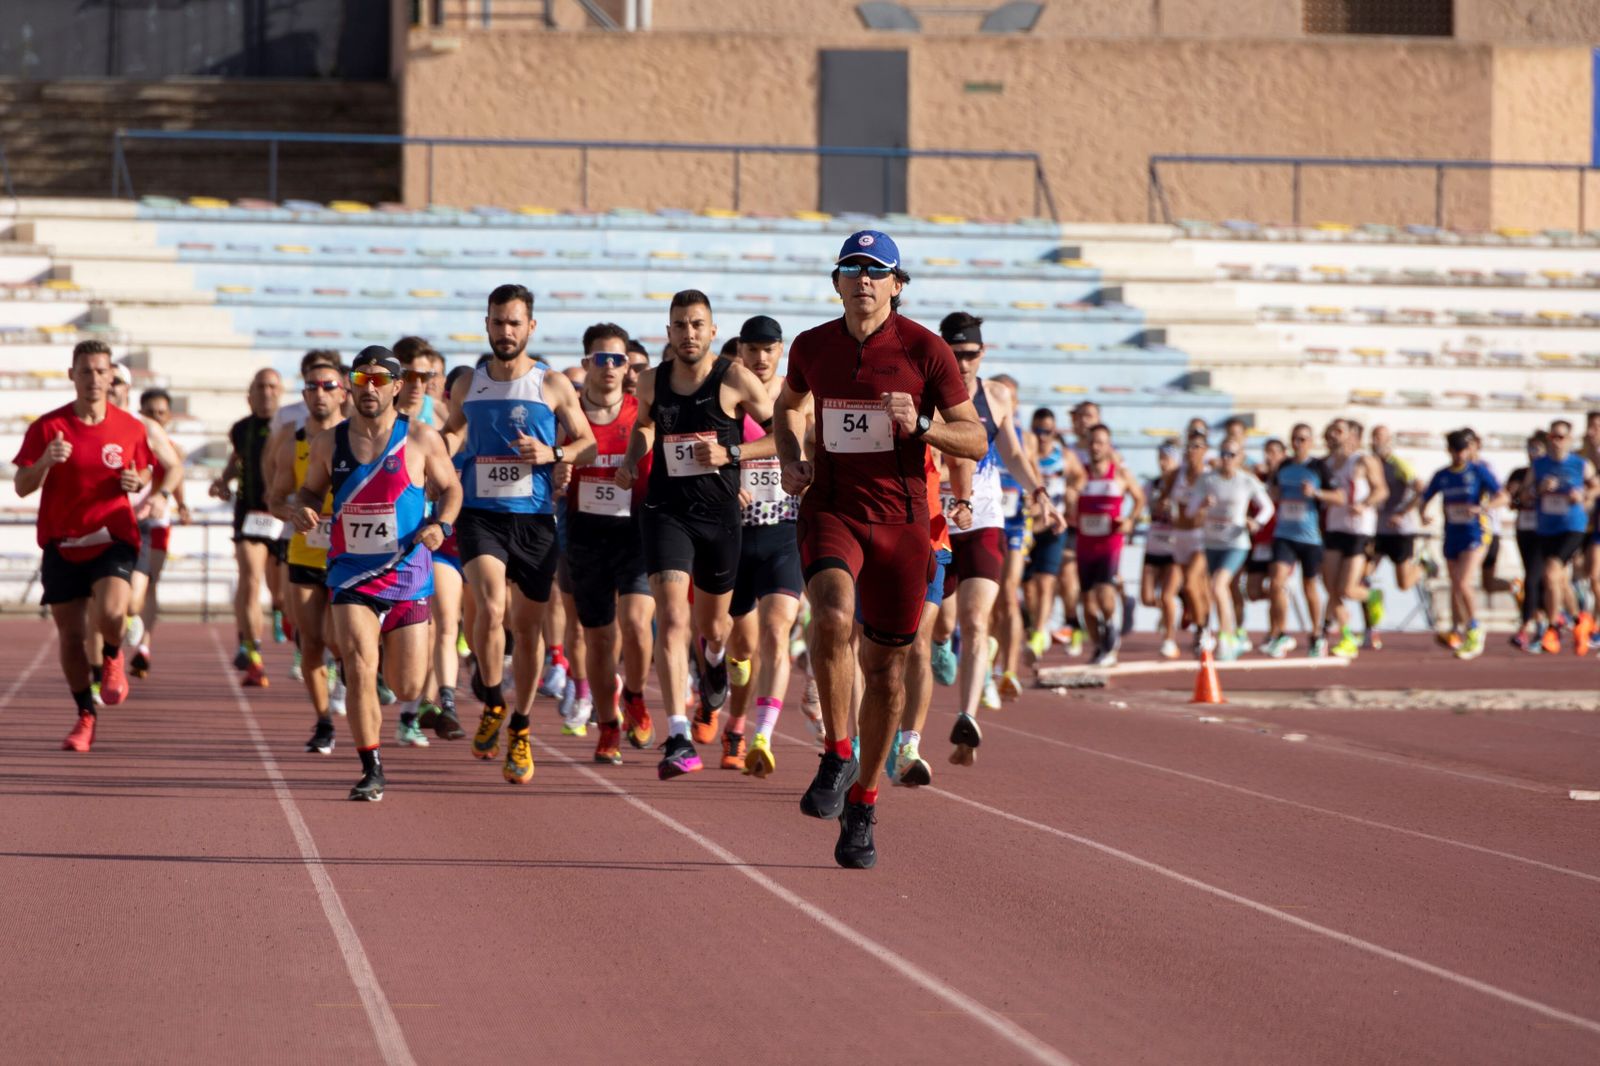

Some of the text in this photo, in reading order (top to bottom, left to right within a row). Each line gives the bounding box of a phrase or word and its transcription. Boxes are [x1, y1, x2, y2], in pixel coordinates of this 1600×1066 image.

[843, 413, 869, 433] 54
[488, 466, 520, 482] 488
[750, 471, 780, 486] 353
[595, 486, 615, 501] 55
[349, 522, 388, 538] 774
